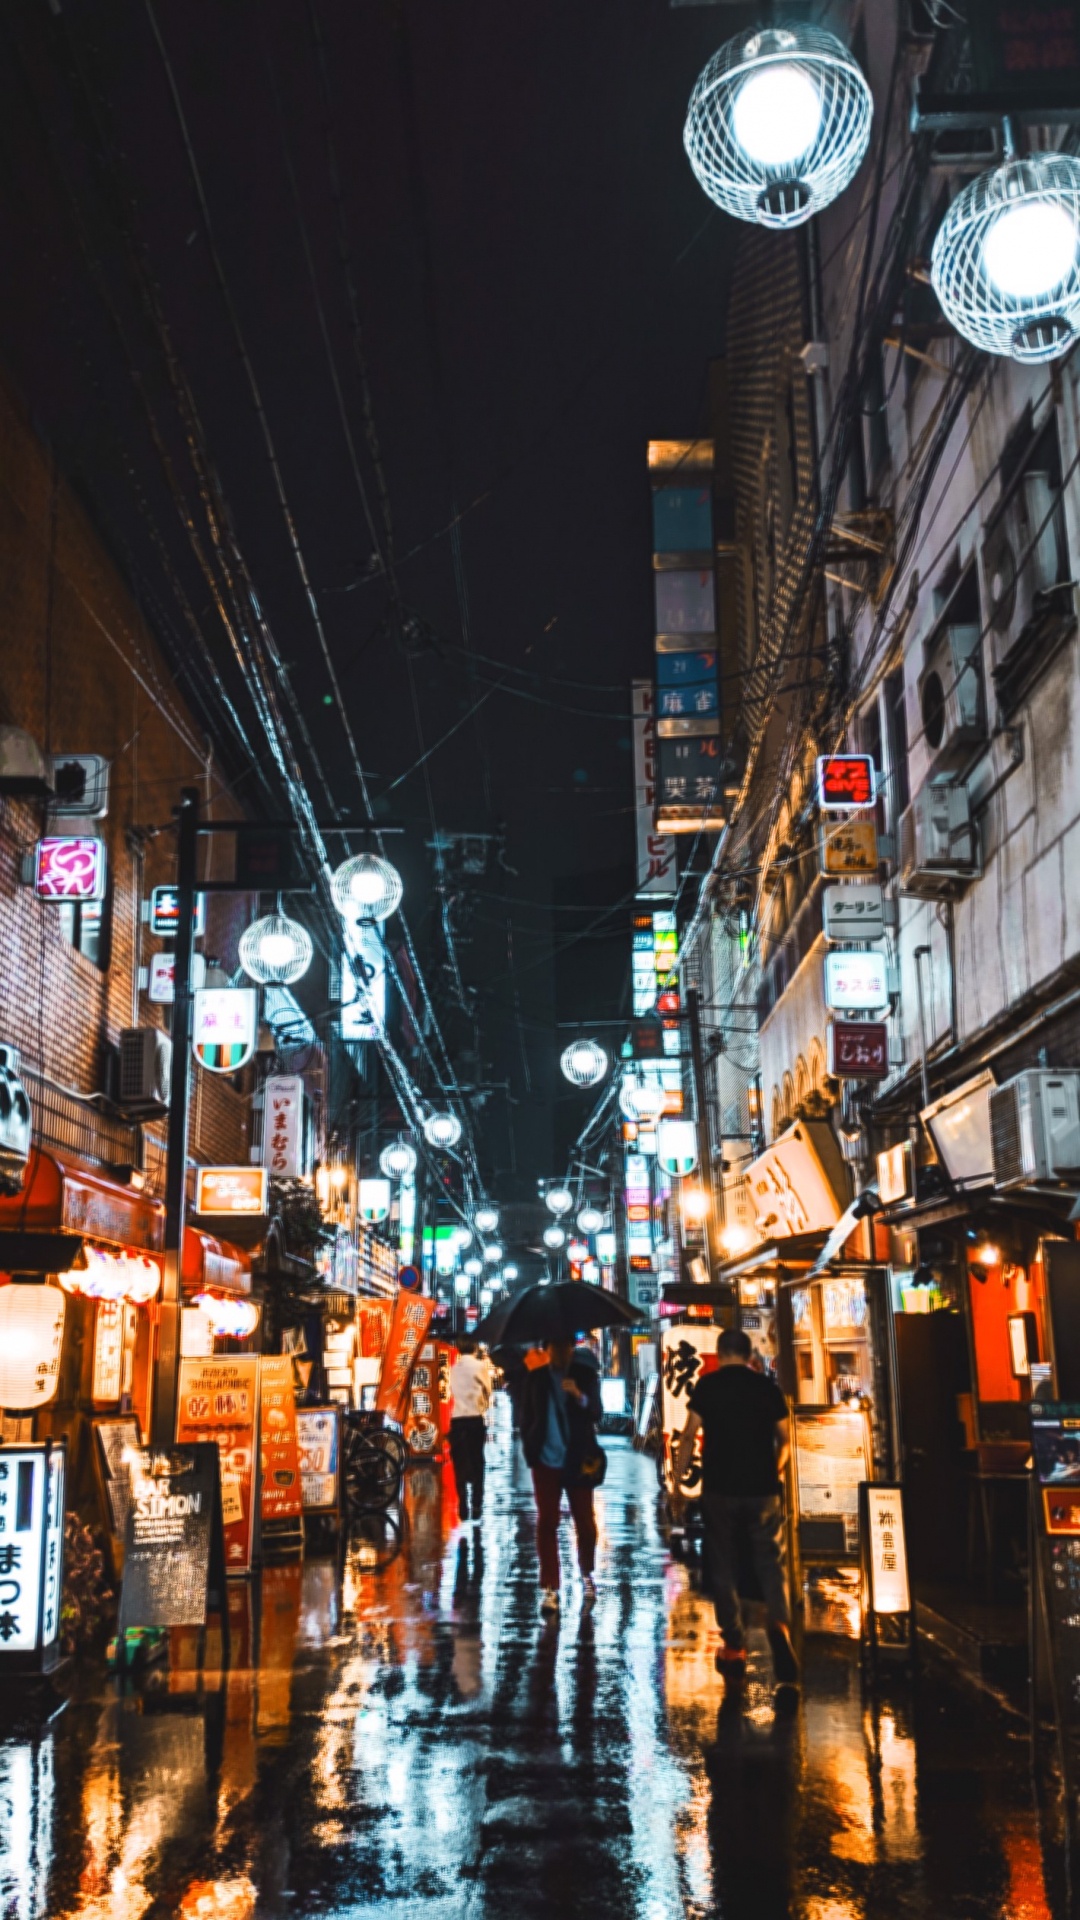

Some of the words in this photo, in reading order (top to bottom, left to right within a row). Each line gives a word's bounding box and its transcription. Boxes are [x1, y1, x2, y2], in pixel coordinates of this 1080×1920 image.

[661, 690, 714, 713] 麻雀
[664, 776, 714, 798] 喫茶
[271, 1097, 291, 1171] いまむら
[134, 1479, 170, 1500] BAR
[133, 1492, 202, 1519] SIMON
